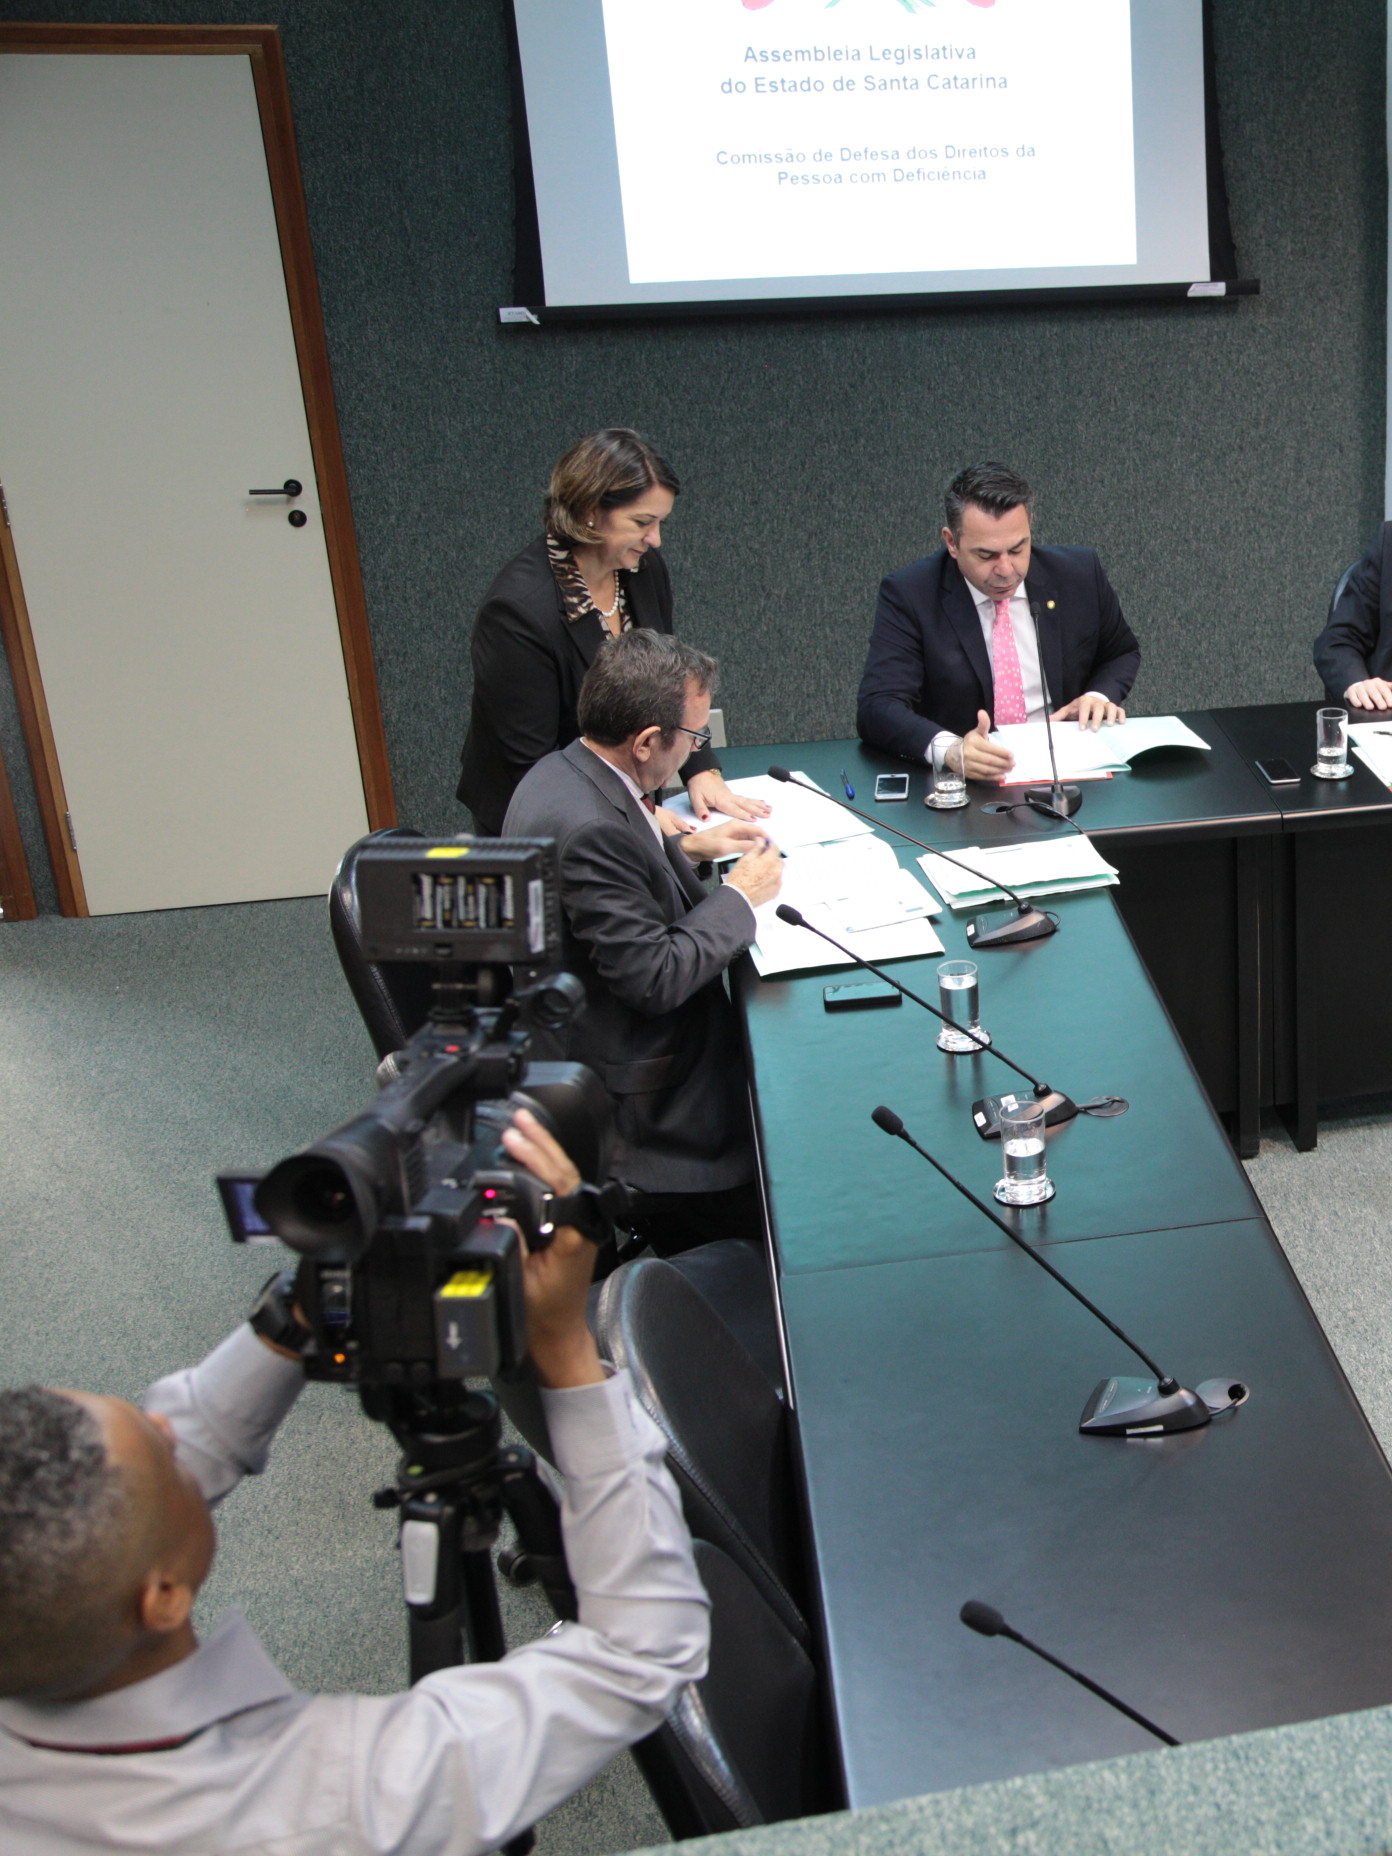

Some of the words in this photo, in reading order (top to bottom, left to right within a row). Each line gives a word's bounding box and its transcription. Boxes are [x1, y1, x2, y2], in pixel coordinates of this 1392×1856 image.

[743, 45, 861, 63] Assembleia
[869, 44, 976, 66] Legislativa
[720, 77, 747, 94] do
[754, 76, 825, 94] Estado
[832, 75, 856, 92] de
[863, 74, 919, 91] Santa
[926, 73, 1008, 90] Catarina
[716, 147, 806, 165] Comissão
[812, 149, 833, 163] de
[840, 147, 900, 162] Defesa
[906, 146, 938, 160] dos
[944, 144, 1009, 159] Direitos
[1016, 144, 1036, 157] da
[777, 171, 843, 185] Pessoa
[849, 173, 886, 183] com
[893, 167, 986, 183] Deficiência
